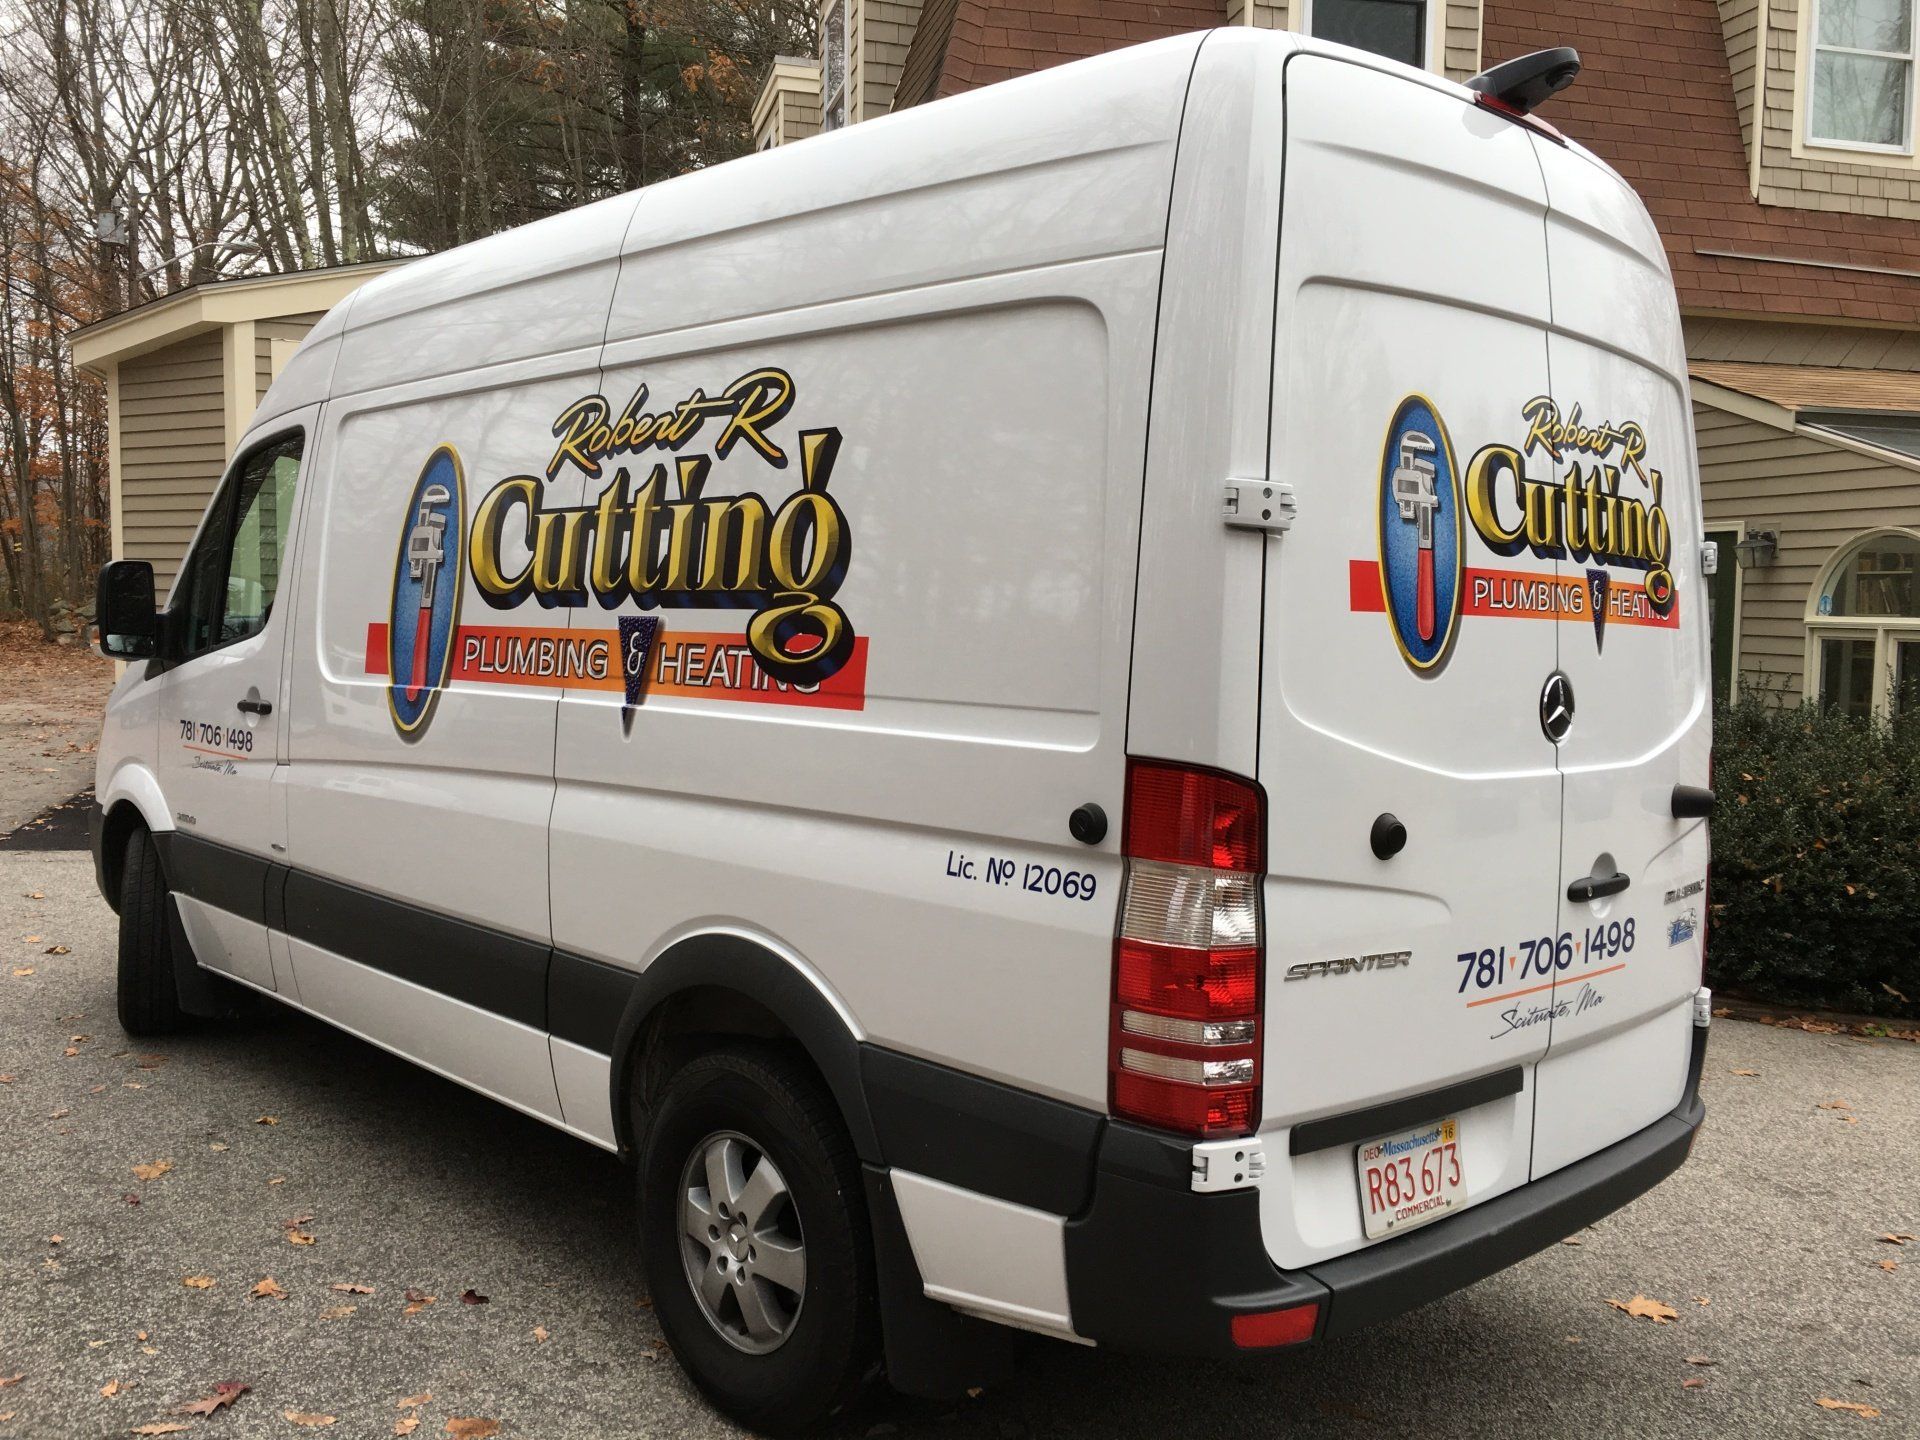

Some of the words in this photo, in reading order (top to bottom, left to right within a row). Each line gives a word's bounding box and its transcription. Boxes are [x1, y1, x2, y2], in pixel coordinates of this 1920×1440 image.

[547, 383, 734, 482] Robert
[715, 366, 796, 470] R
[1521, 395, 1623, 464] Robert
[1618, 421, 1650, 488] R
[468, 427, 855, 684] Cutting
[1465, 443, 1675, 617] Cutting
[1473, 576, 1583, 614] PLUMBING
[1593, 580, 1602, 610] &
[462, 635, 609, 679] PLUMBING
[626, 631, 644, 676] &
[657, 642, 820, 693] HEATI
[946, 851, 977, 880] Lic.
[1023, 863, 1097, 901] 12069
[1284, 951, 1412, 981] SPRINTER
[1457, 946, 1505, 993] 781
[1519, 932, 1573, 980] 706
[1584, 917, 1636, 964] 1498
[1383, 1131, 1439, 1157] Massachusetts
[1444, 1127, 1454, 1139] 16
[1367, 1157, 1416, 1214] R83
[1422, 1143, 1460, 1196] 673
[1396, 1195, 1445, 1221] COMMERCIAL
